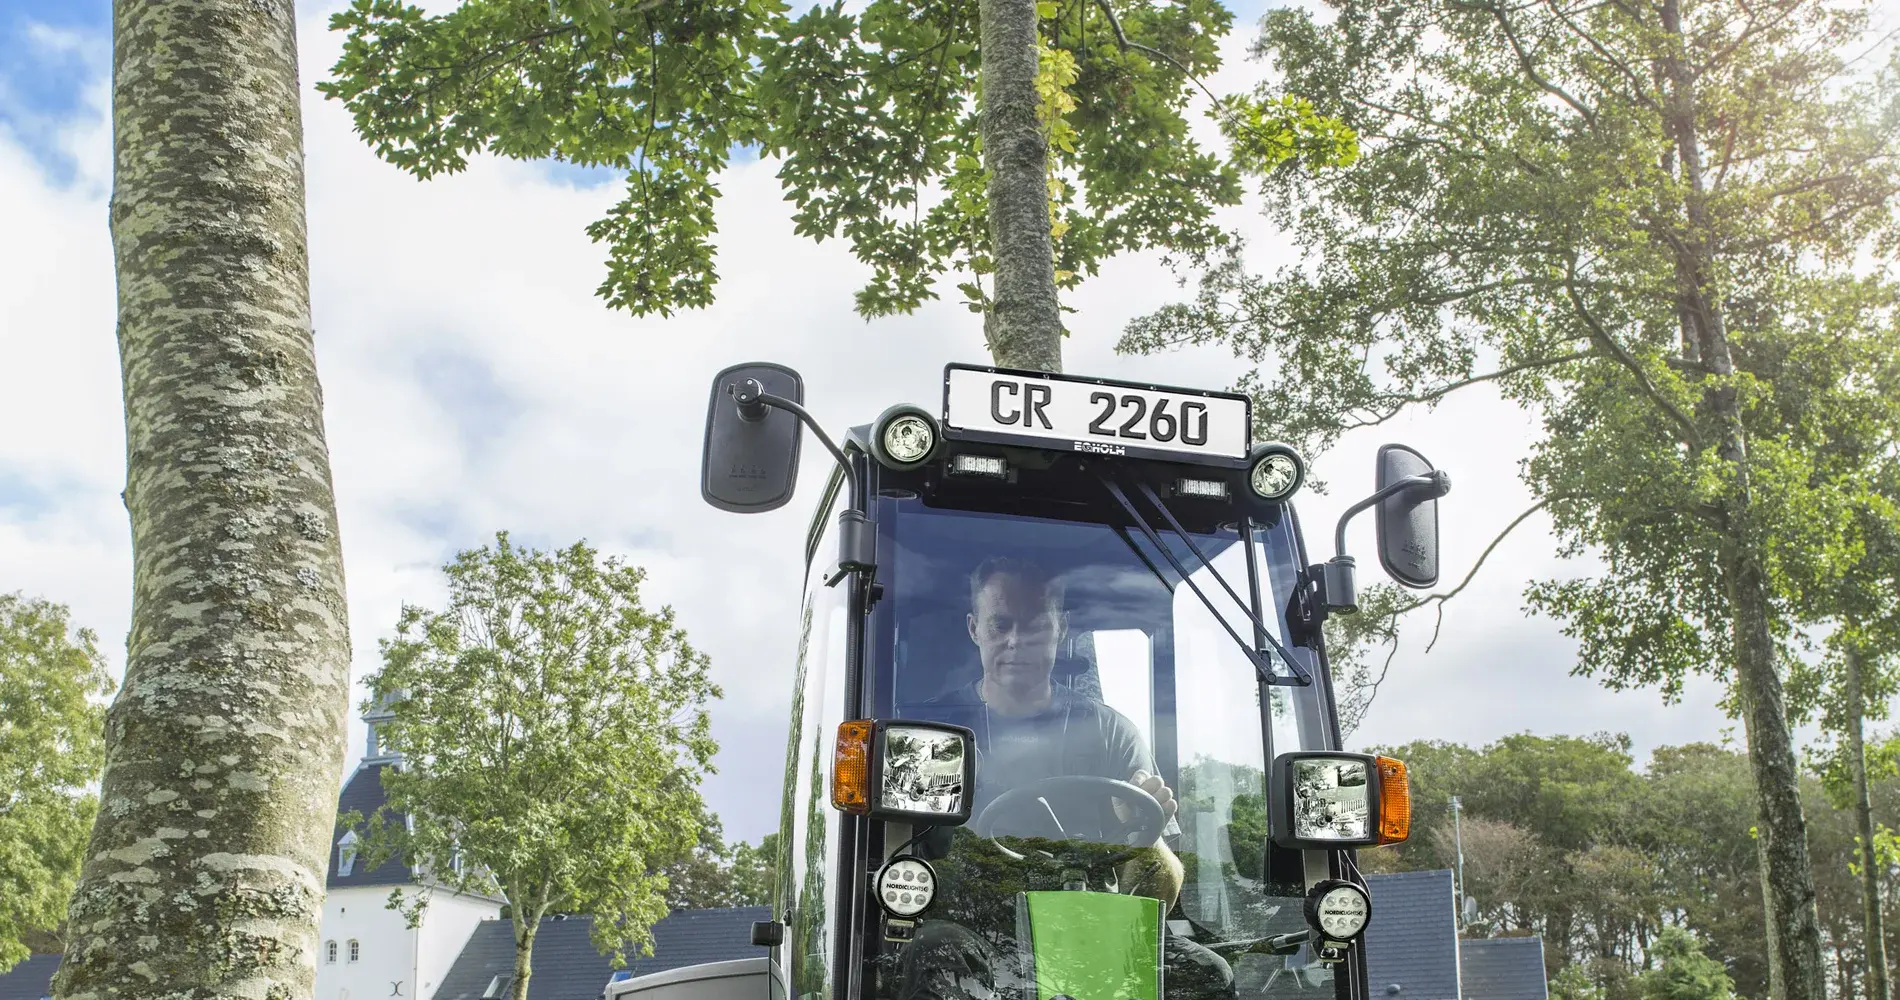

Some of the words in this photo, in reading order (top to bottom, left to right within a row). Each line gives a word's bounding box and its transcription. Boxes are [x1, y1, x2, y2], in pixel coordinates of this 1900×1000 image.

[990, 380, 1053, 430] CR
[1088, 391, 1208, 446] 2260
[1074, 441, 1125, 456] EGHOLM
